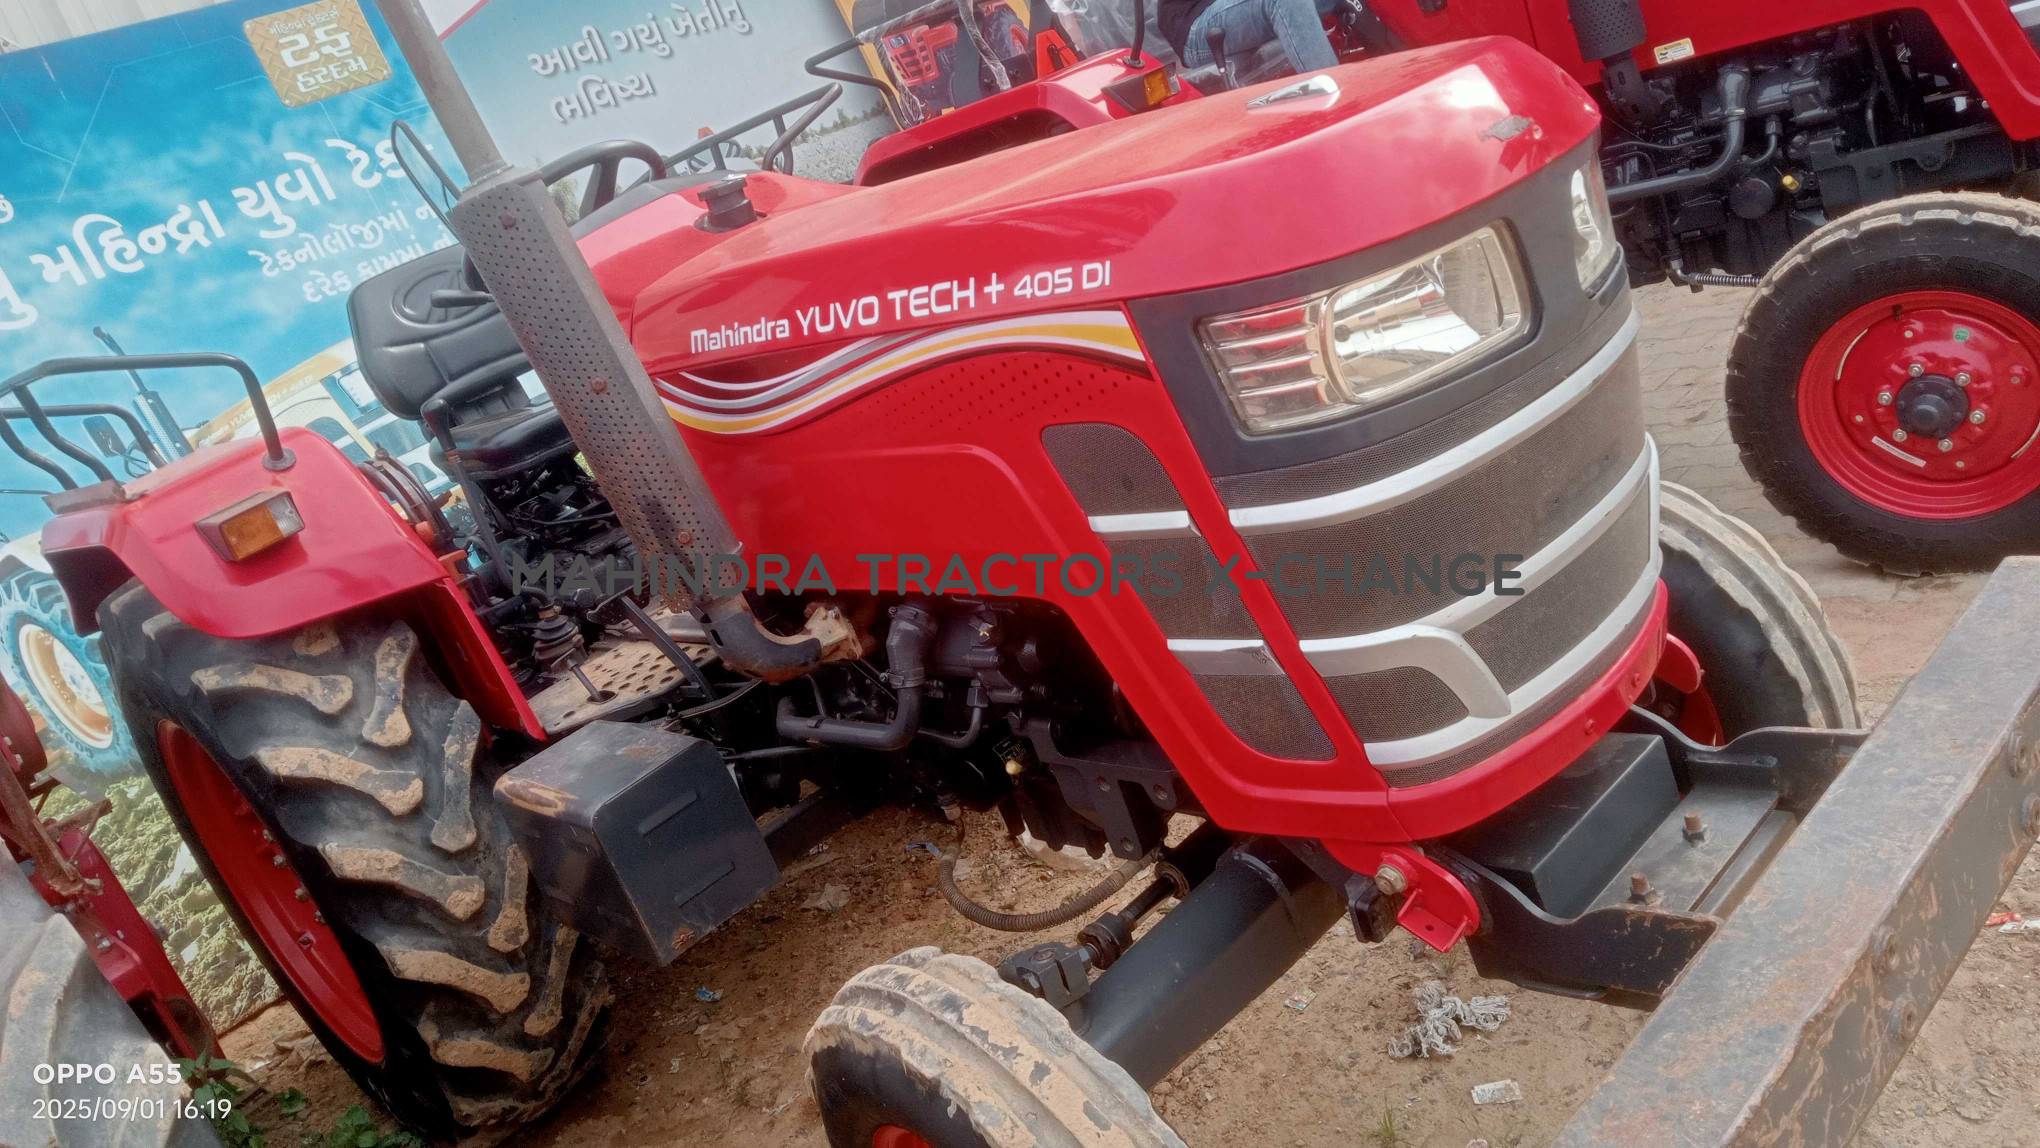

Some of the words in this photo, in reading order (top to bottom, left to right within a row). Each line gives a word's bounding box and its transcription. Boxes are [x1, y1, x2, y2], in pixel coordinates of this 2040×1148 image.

[278, 23, 353, 69] ટફ
[527, 25, 608, 76] આવી
[611, 13, 672, 57] ગયું
[550, 72, 655, 123] ભવિષ્ય
[29, 199, 226, 287] મહિન્દ્રા
[231, 151, 337, 239] યુવો
[302, 269, 352, 303] દરેક
[690, 316, 790, 354] Mahindra
[795, 296, 880, 337] YUVO
[886, 277, 976, 321] TECH
[983, 271, 1006, 305] +
[1013, 266, 1074, 300] 405
[1081, 260, 1111, 289] DI
